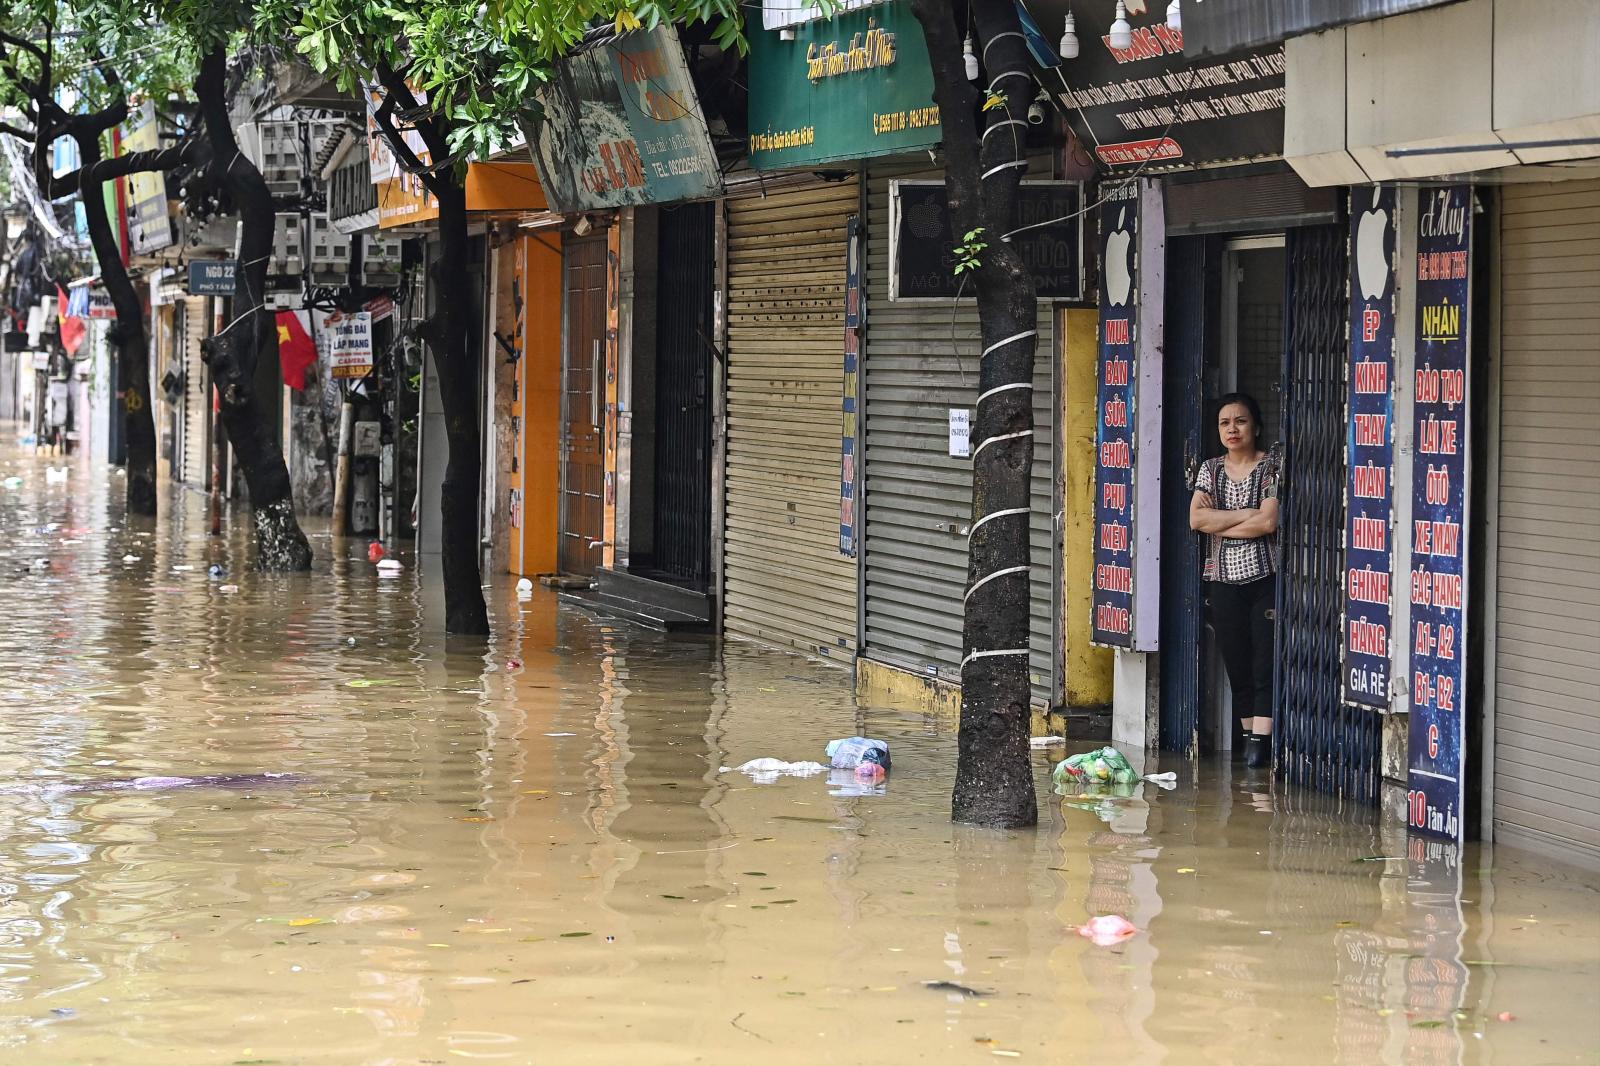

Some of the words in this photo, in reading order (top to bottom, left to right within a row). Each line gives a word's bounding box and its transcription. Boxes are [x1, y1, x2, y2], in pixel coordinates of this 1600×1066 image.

[1106, 319, 1129, 344] MUA
[1363, 304, 1380, 342] ÉP
[1423, 297, 1459, 345] NHẬN
[1105, 360, 1128, 385] BÁN
[1355, 356, 1387, 394] KÍNH
[1416, 363, 1439, 404] ĐÀO
[1441, 369, 1463, 411] TẠO
[1105, 394, 1127, 427] SỬA
[1355, 415, 1387, 446] THAY
[1420, 413, 1439, 454] LÁI
[1440, 420, 1457, 455] XE
[1100, 437, 1130, 469] CHỮA
[1103, 483, 1126, 511] PHỤ
[1354, 460, 1385, 499] MÀN
[1101, 523, 1128, 555] KIỆN
[1353, 514, 1385, 553] HÌNH
[1414, 520, 1431, 554] XE
[1432, 515, 1459, 557] MÁY
[1097, 560, 1131, 592] CHÍNH
[1349, 564, 1389, 605] CHÍNH
[1410, 564, 1431, 606] CÁC
[1432, 571, 1461, 615] HẠNG
[1097, 604, 1129, 634] HÃNG
[1350, 616, 1386, 658] HÃNG
[1437, 624, 1454, 661] A2
[1350, 667, 1368, 692] GIÁ
[1371, 664, 1385, 697] RẺ
[1437, 674, 1453, 712] B2
[1428, 724, 1438, 760] C
[1408, 789, 1426, 828] 10
[1427, 805, 1443, 832] Tân
